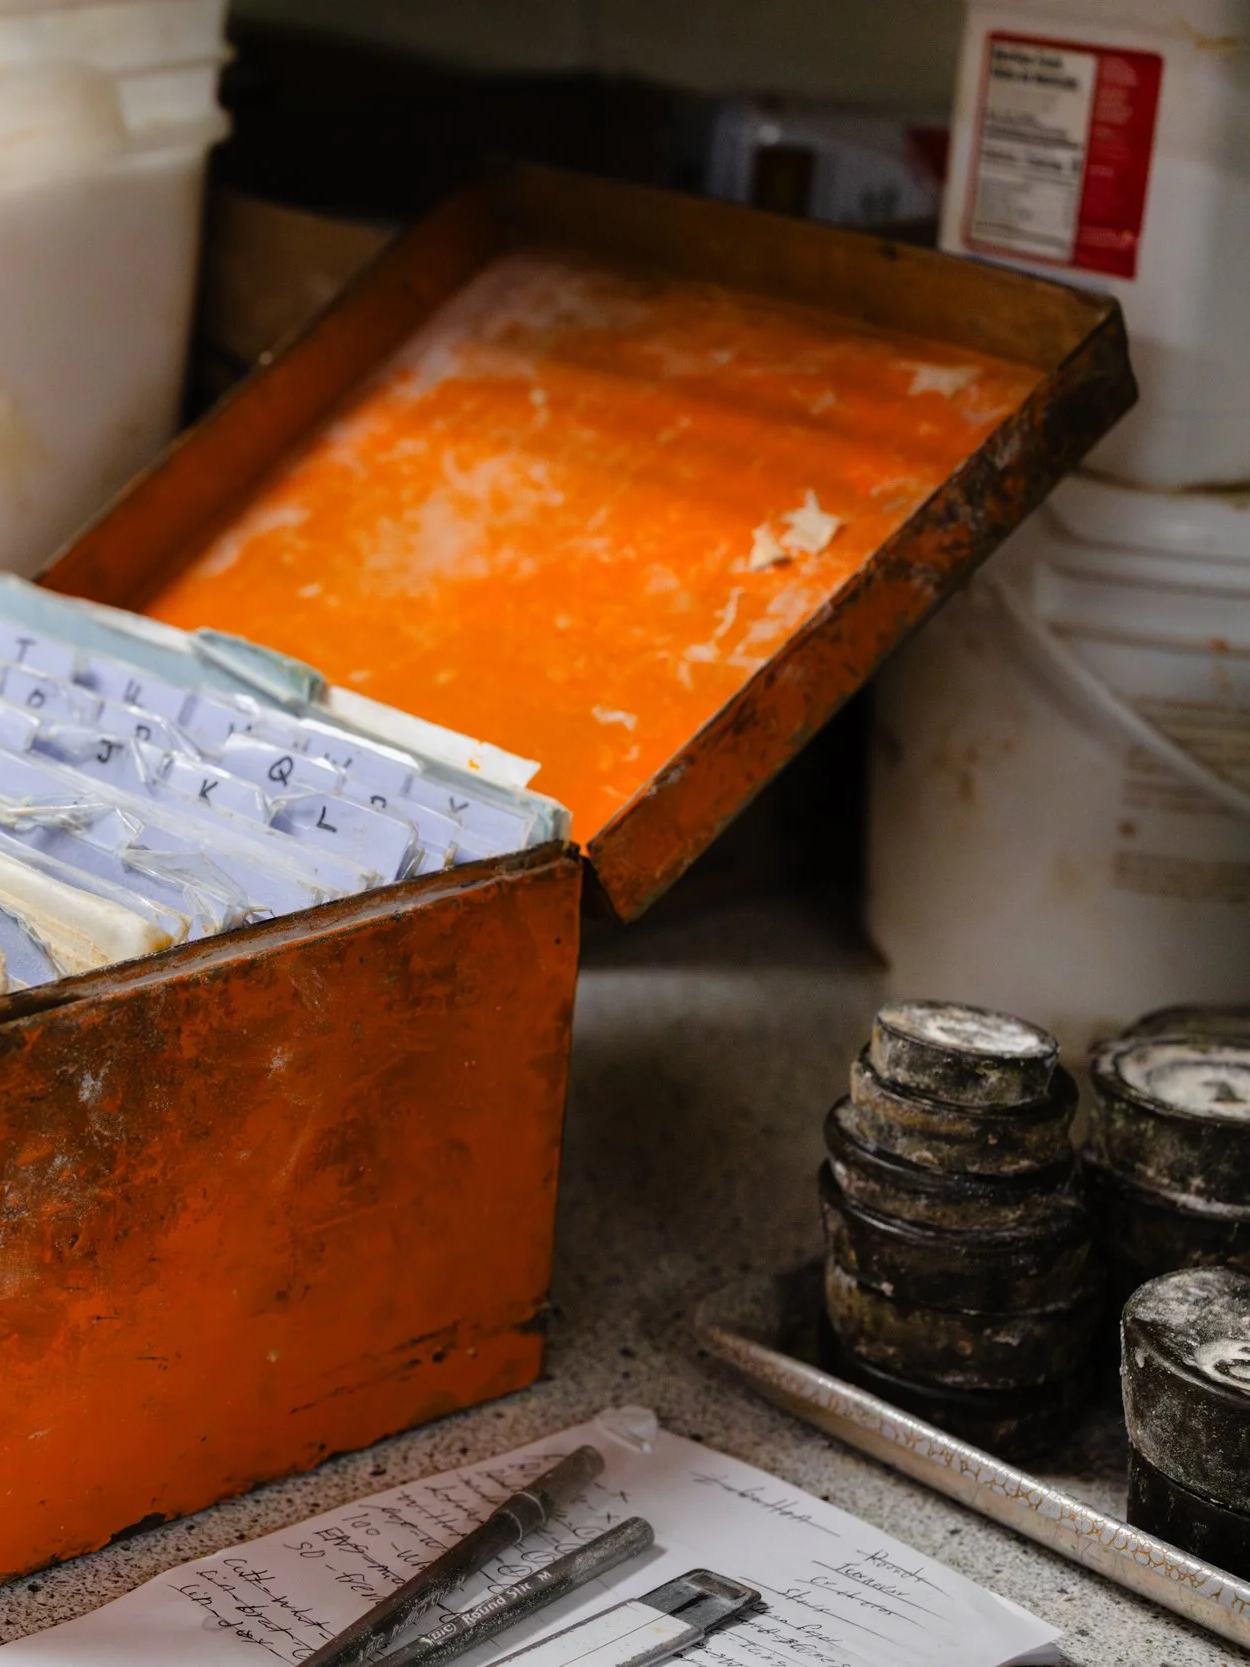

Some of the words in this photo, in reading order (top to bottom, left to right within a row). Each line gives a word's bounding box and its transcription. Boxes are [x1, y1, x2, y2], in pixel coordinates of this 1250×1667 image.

[15, 636, 37, 663] T
[97, 738, 124, 763] J
[268, 756, 294, 786] Q
[199, 779, 218, 806] K
[316, 806, 338, 833] L
[342, 1513, 381, 1536] 100
[432, 1623, 456, 1641] BIC
[461, 1596, 506, 1626] Round
[537, 1569, 553, 1583] M
